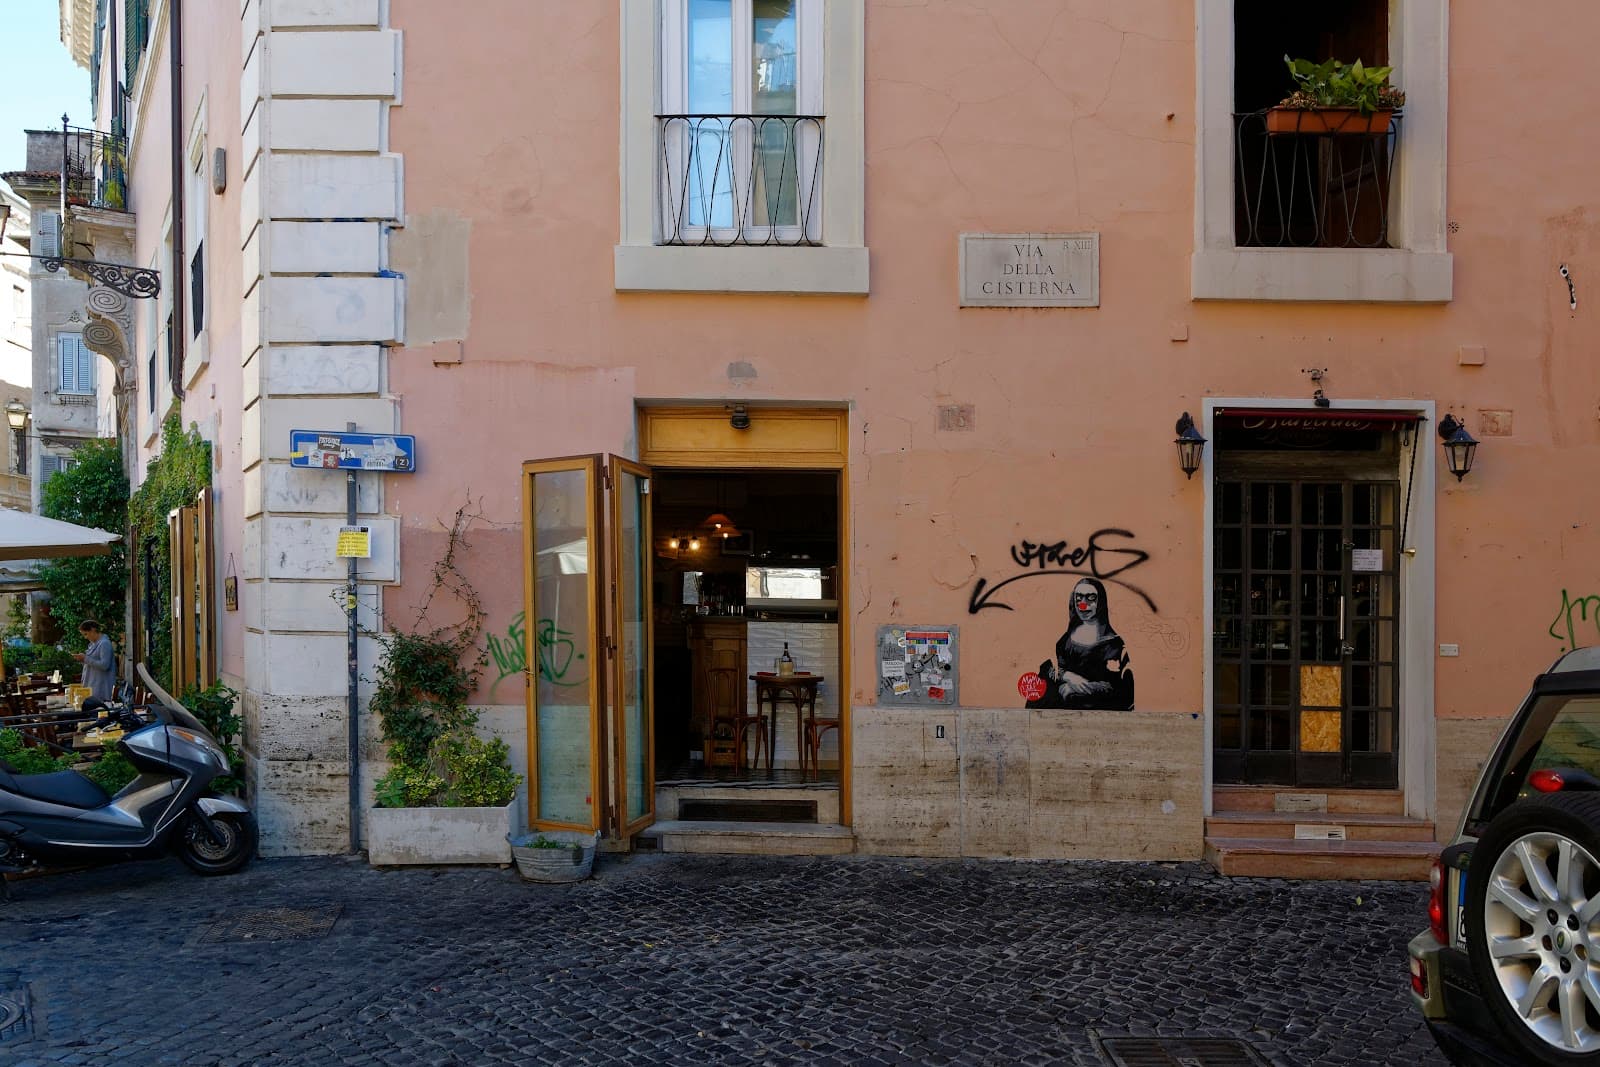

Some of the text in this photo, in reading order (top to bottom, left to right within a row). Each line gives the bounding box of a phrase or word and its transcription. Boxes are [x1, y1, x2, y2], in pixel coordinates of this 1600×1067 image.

[1014, 244, 1044, 257] VIA
[1003, 263, 1055, 275] DELLA
[982, 281, 1077, 295] CISTERNA
